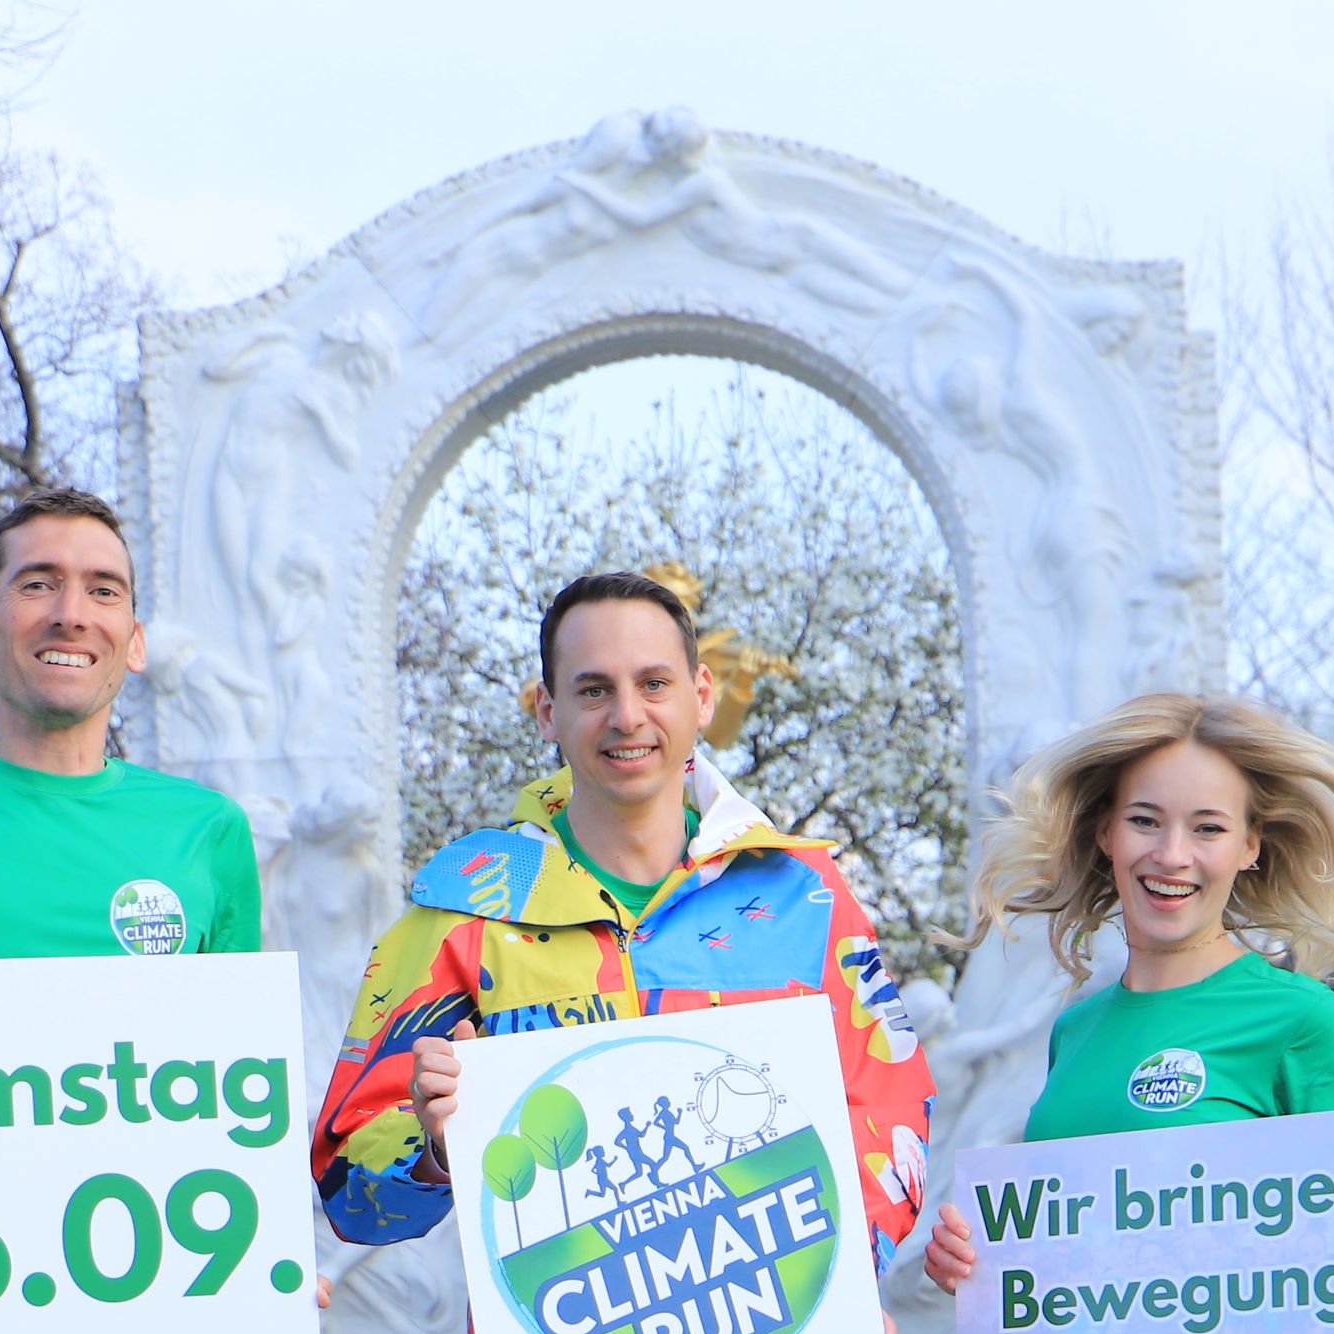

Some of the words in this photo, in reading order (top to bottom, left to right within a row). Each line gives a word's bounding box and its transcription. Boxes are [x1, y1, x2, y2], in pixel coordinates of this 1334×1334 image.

[123, 924, 183, 940] CLIMATE
[143, 939, 171, 954] RUN
[1132, 1079, 1197, 1095] CLIMATE
[1144, 1091, 1179, 1104] RUN
[599, 1176, 726, 1243] VIENNA
[974, 1177, 1095, 1242] Wir
